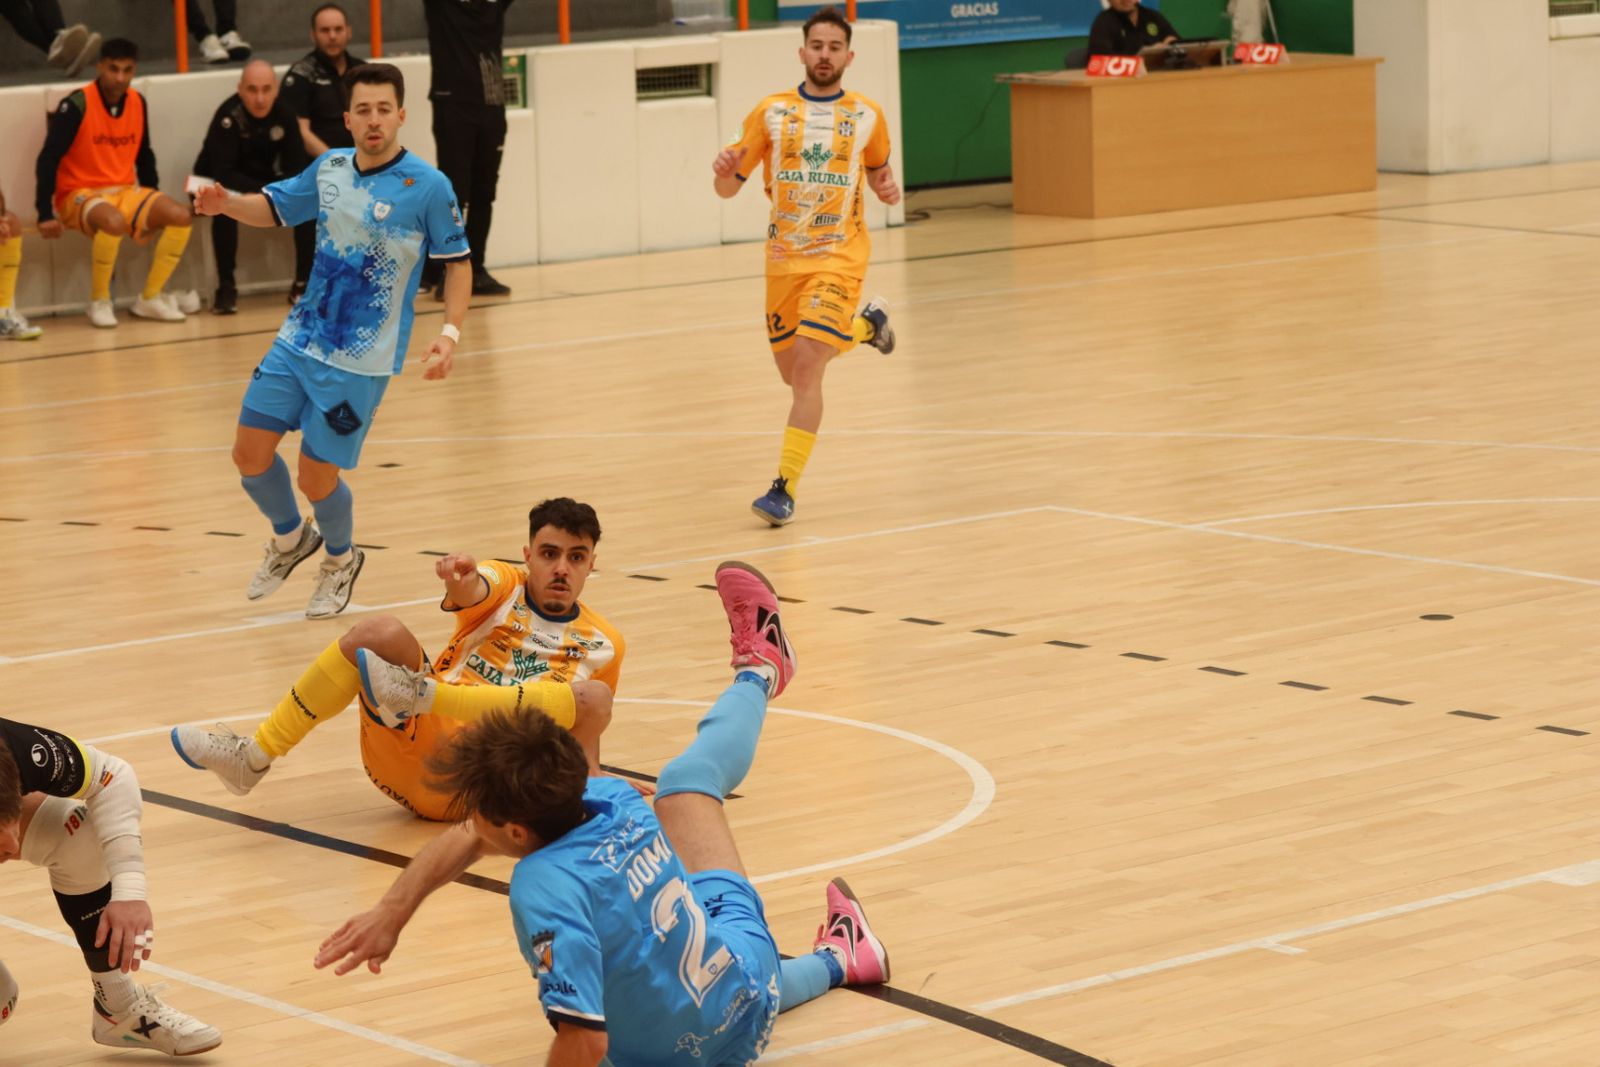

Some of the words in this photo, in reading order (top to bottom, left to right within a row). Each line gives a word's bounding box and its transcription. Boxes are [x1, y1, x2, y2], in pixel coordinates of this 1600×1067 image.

[951, 3, 999, 17] GRACIAS
[776, 170, 804, 182] CAJA
[808, 172, 851, 186] RURAL
[466, 654, 503, 687] CAJA
[651, 876, 736, 1009] 2
